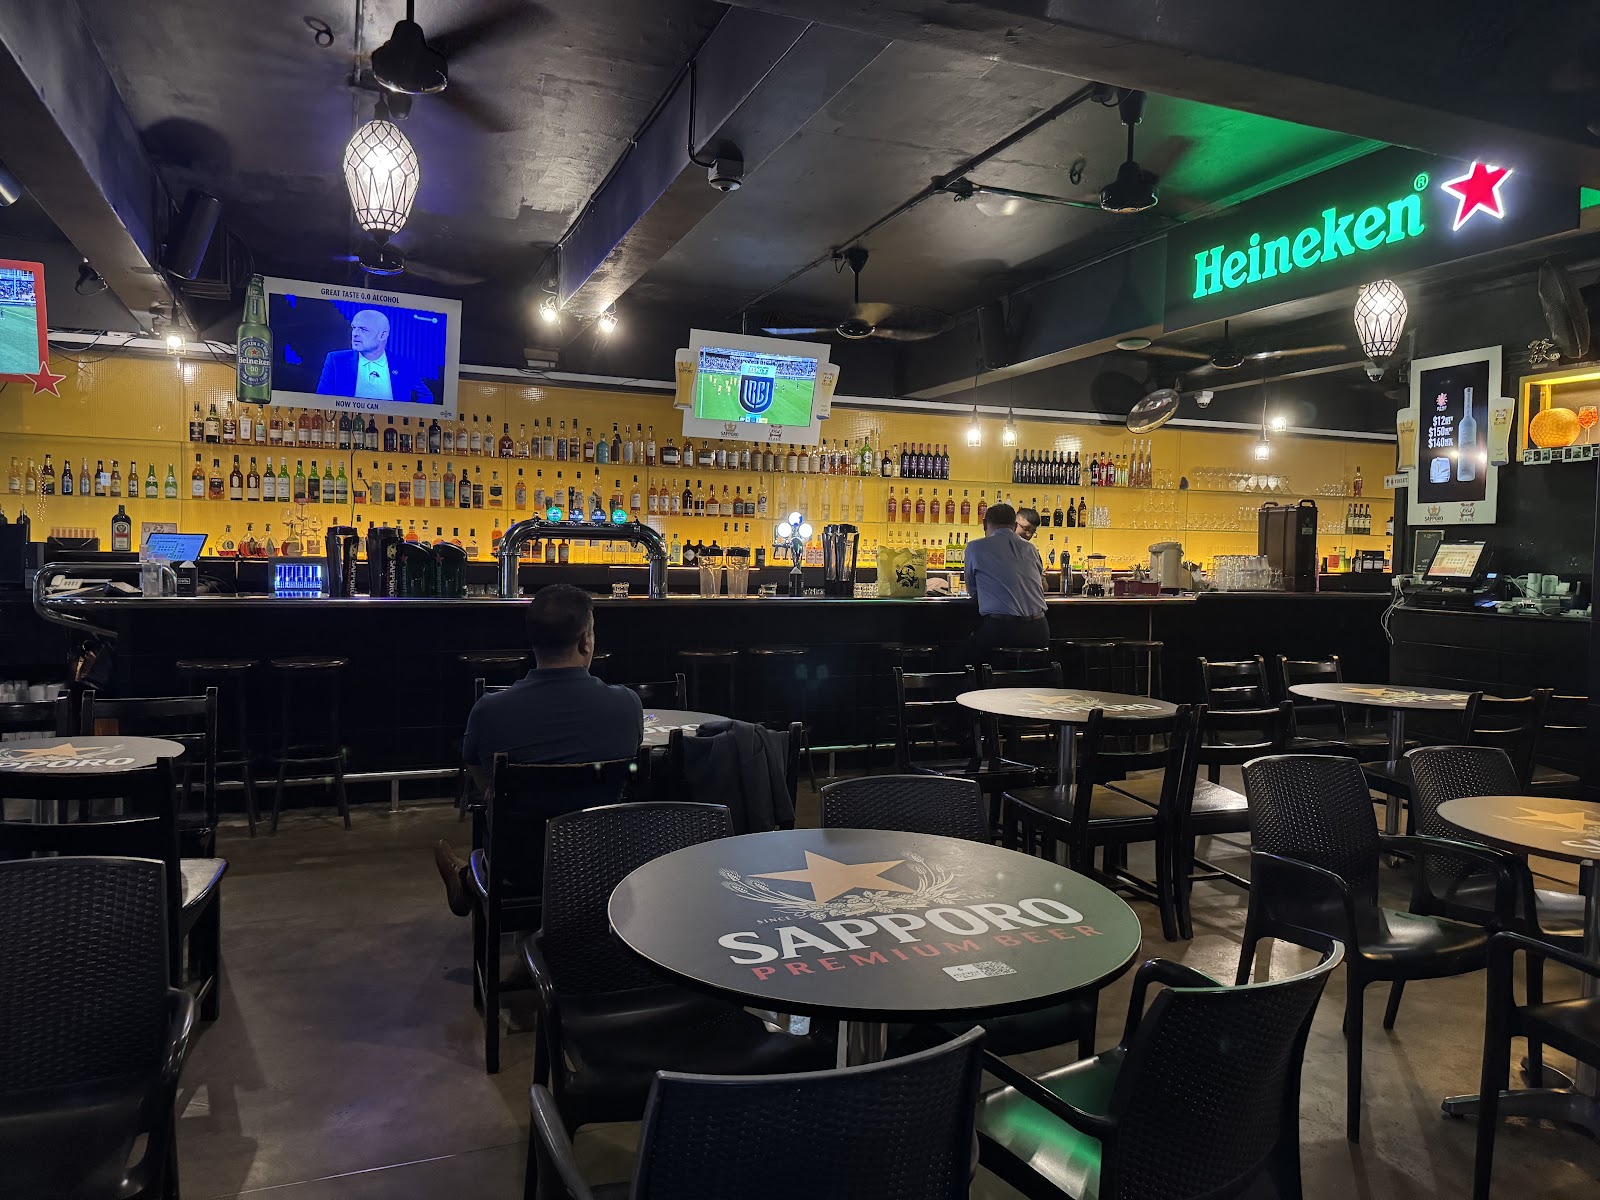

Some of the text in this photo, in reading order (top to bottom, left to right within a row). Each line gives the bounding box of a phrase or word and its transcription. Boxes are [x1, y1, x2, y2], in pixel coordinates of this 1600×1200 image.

[320, 287, 400, 304] GREAT TASTE 0.0 ALCOHOL
[335, 400, 379, 410] NOW YOU CAN
[1432, 415, 1445, 427] $12
[1428, 426, 1446, 438] $150
[1428, 437, 1446, 449] $140
[756, 916, 792, 925] SINCE
[717, 897, 1085, 966] SAPPORO
[752, 924, 1104, 981] PREMIUM BEER
